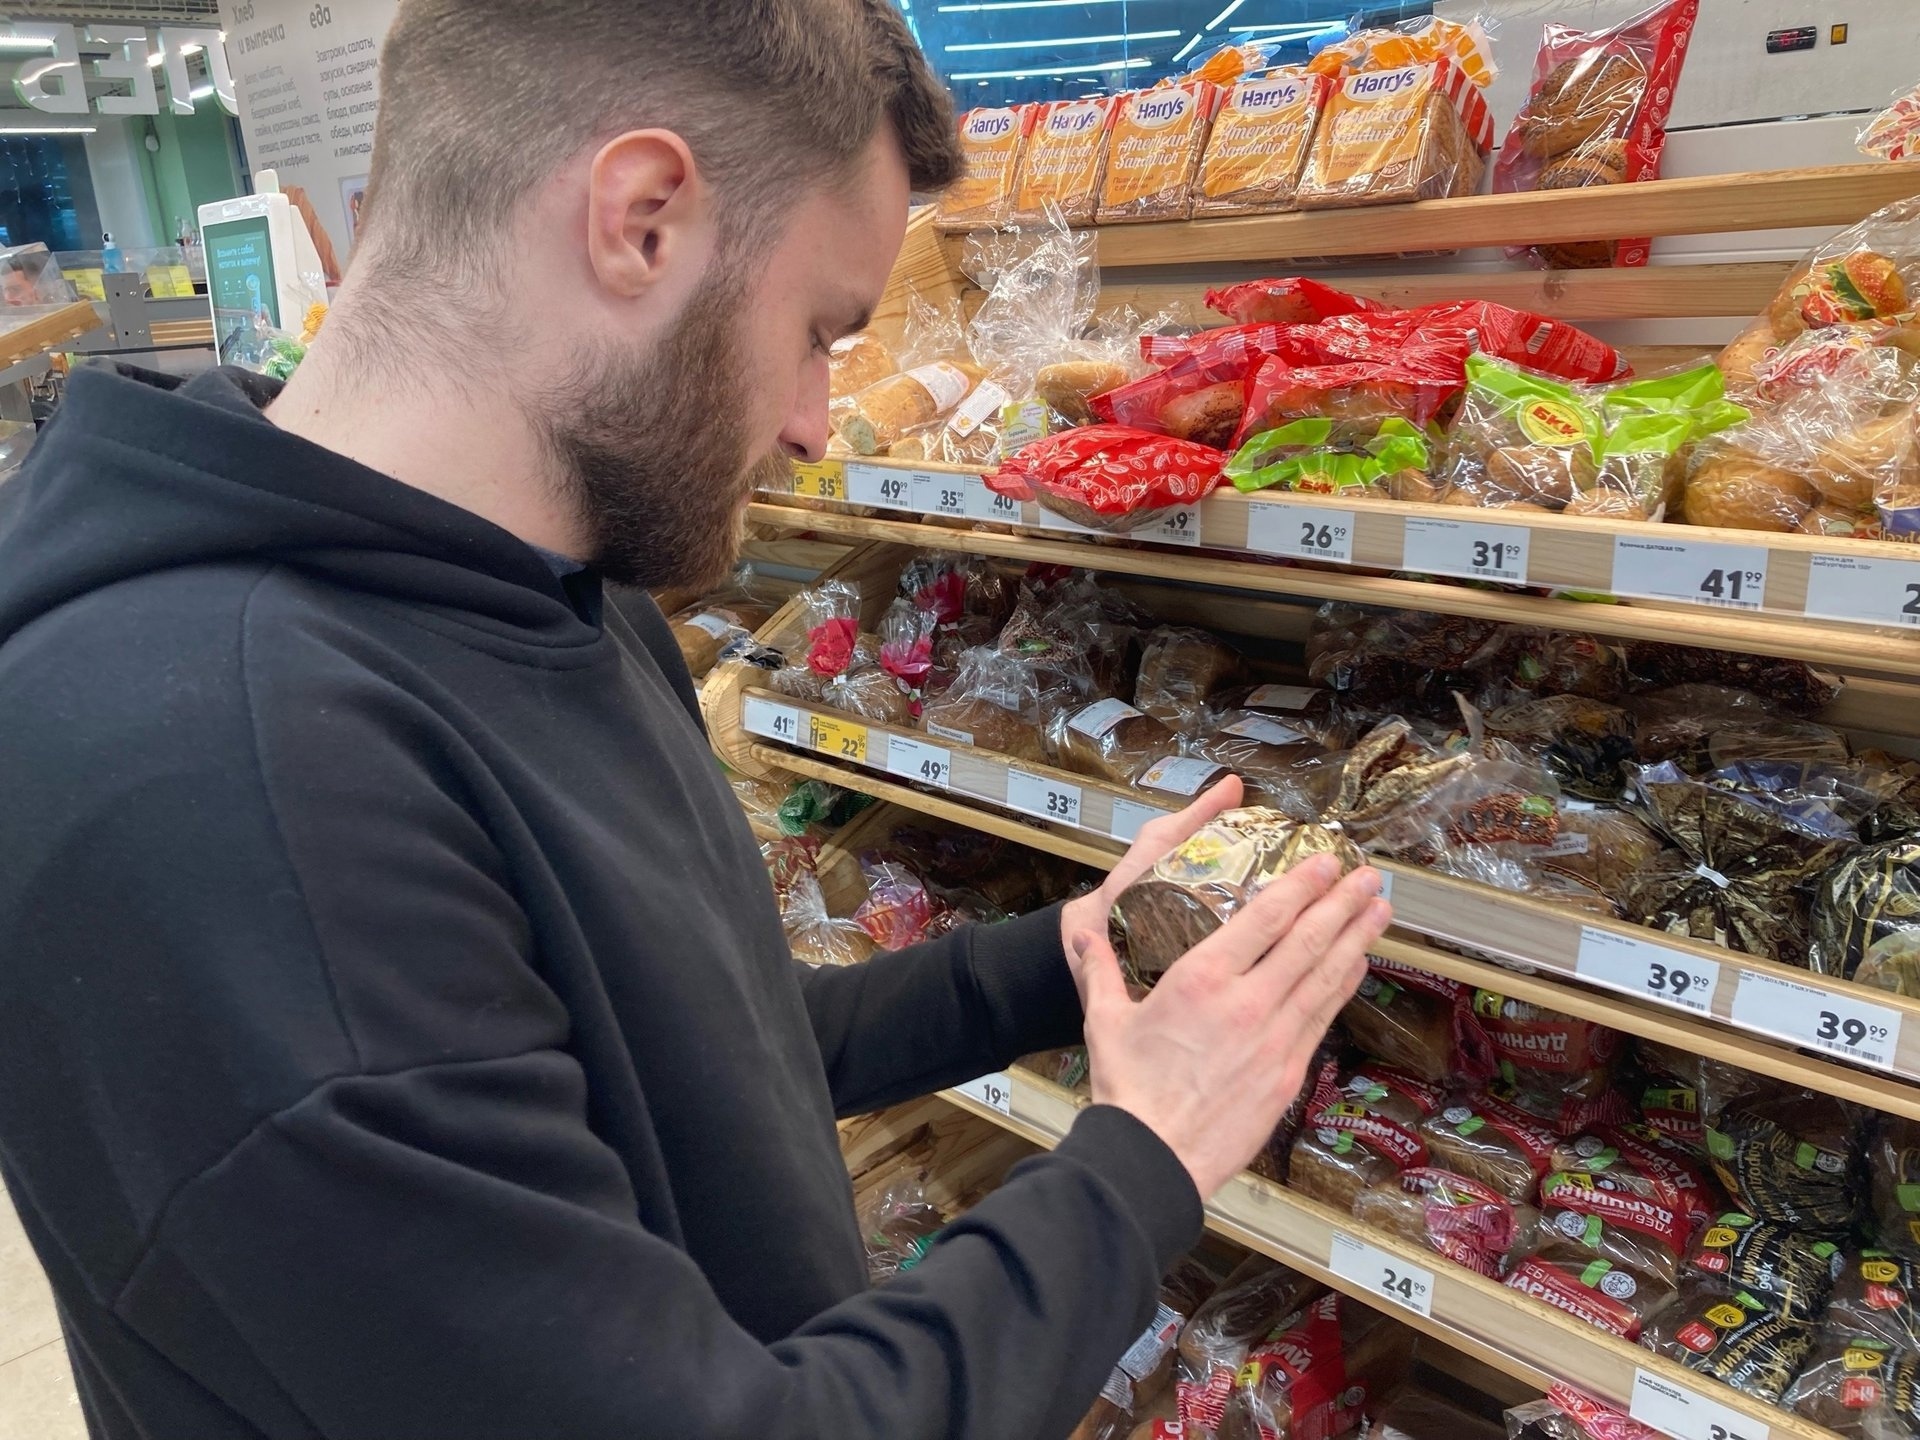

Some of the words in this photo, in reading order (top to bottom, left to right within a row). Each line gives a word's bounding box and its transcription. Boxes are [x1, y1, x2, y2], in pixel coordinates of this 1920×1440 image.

[232, 3, 254, 25] Хлеб
[310, 4, 331, 28] еда
[237, 40, 244, 54] и
[246, 24, 285, 51] выпечка
[316, 47, 347, 63] Завтраки,
[348, 37, 375, 53] салаты,
[320, 65, 346, 82] закуски,
[323, 89, 341, 102] супы,
[341, 81, 373, 96] основные
[327, 107, 349, 120] блюда,
[349, 101, 379, 114] комплек
[305, 133, 322, 144] тесте,
[330, 125, 352, 140] обеды,
[1118, 130, 1188, 150] American
[1220, 121, 1299, 145] American
[962, 147, 1012, 163] merican
[1217, 136, 1289, 158] Sandwich
[1533, 406, 1579, 434] БКК
[818, 477, 835, 497] 35
[881, 479, 900, 499] 49
[900, 482, 908, 490] 99
[941, 490, 957, 507] 35
[994, 494, 1013, 510] 40
[1301, 522, 1332, 548] 26
[1334, 527, 1346, 537] 99
[1472, 541, 1503, 568] 31
[1506, 545, 1520, 555] 99
[1813, 561, 1856, 569] амбургеров
[1700, 569, 1743, 599] 41
[1745, 572, 1762, 582] 99
[774, 716, 787, 733] 41
[842, 738, 858, 757] 22
[921, 760, 940, 779] 49
[1047, 792, 1068, 814] 33
[1069, 798, 1077, 806] 99
[1648, 963, 1691, 995] 39
[1693, 976, 1709, 987] 99
[1756, 976, 1788, 987] ЧУДОХЛЕБ
[1816, 1011, 1867, 1046] 39
[1869, 1025, 1887, 1038] 99
[984, 1084, 1001, 1104] 19
[1635, 1214, 1673, 1238] ХЛЕБ
[1382, 1268, 1412, 1299] 24
[1414, 1282, 1426, 1293] 99
[1715, 1317, 1791, 1377] родинский
[1729, 1359, 1759, 1390] хлеб
